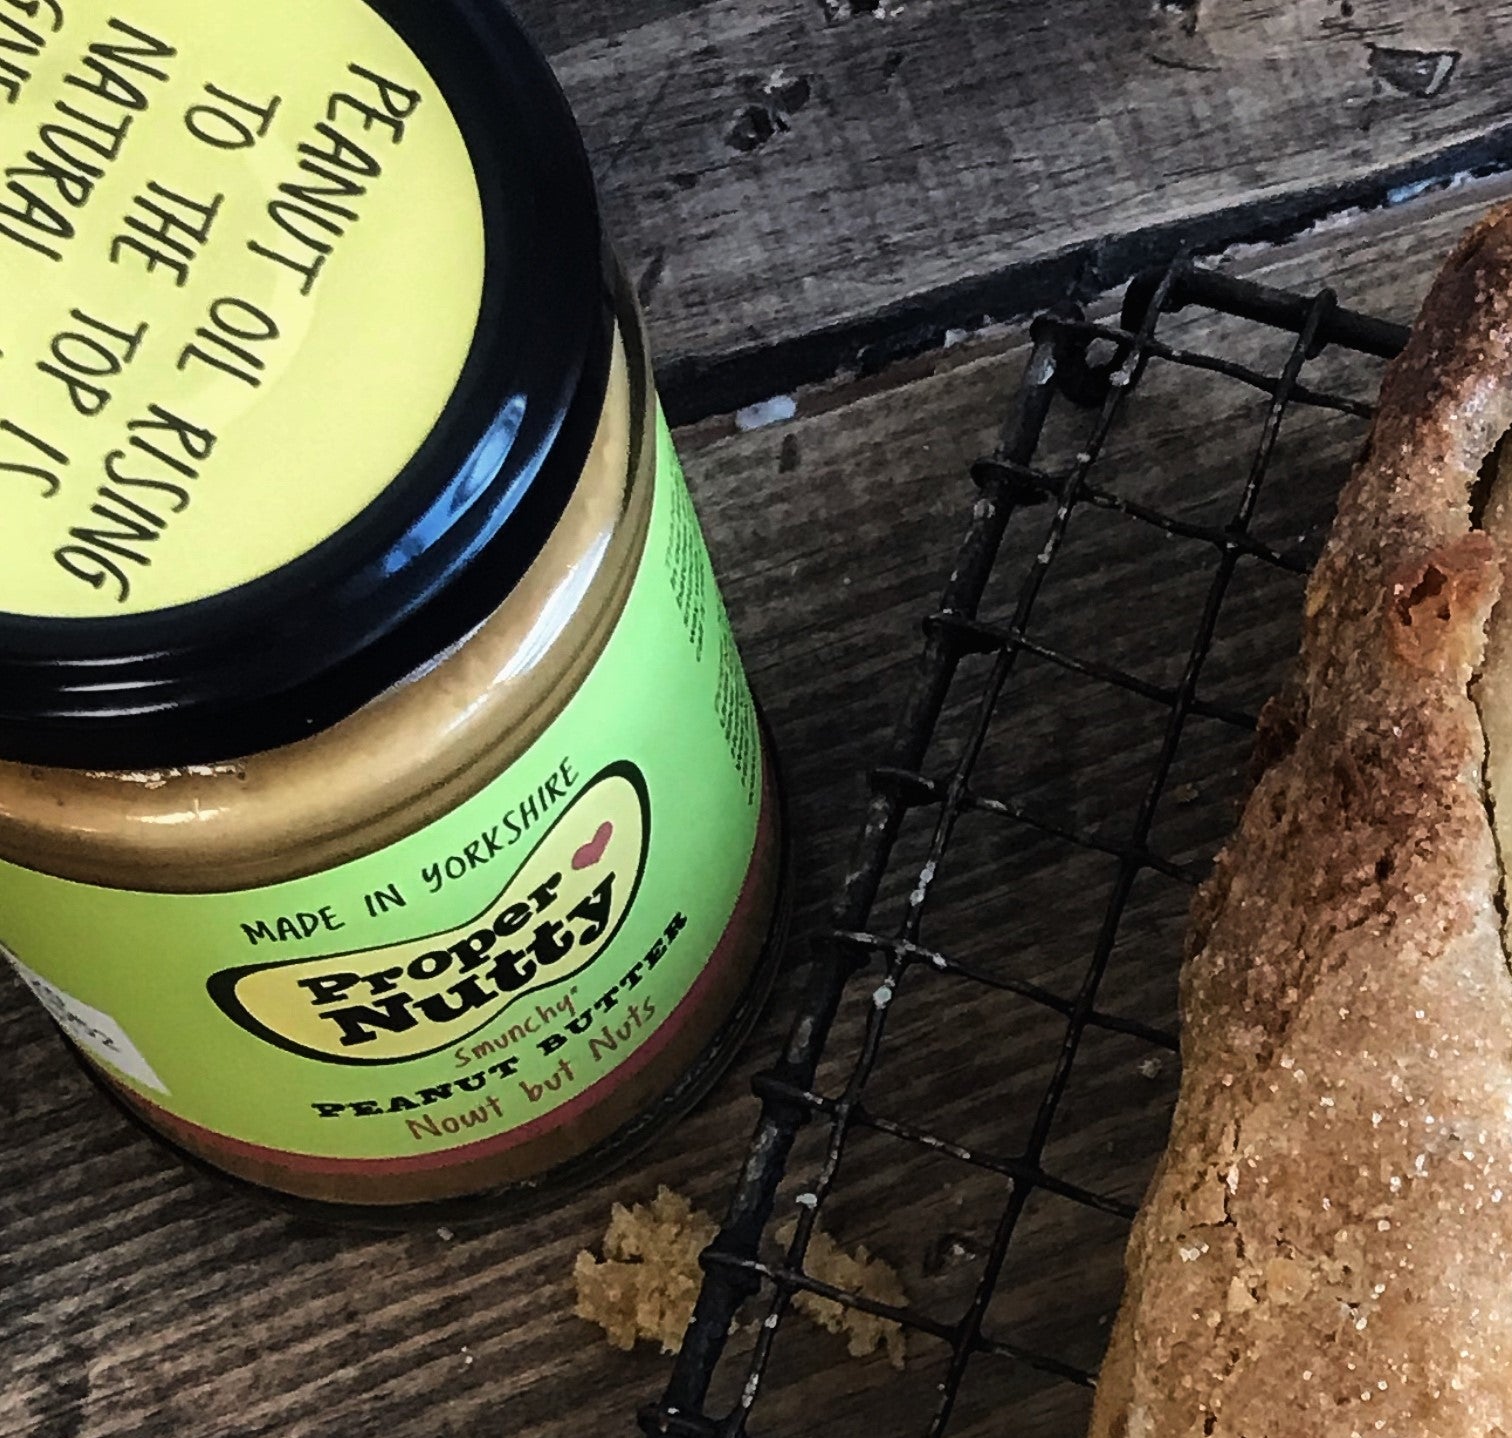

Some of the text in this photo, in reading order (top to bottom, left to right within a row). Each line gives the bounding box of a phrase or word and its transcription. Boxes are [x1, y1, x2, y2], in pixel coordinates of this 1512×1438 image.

[184, 83, 282, 150] TO
[109, 180, 224, 287] THE
[36, 307, 149, 417] TOP
[53, 62, 421, 602] PEANUT OIL RISING
[241, 756, 579, 946] MADE IN YORKSHIRE
[298, 871, 563, 1006] Proper
[319, 871, 616, 1047] Nutty
[311, 911, 688, 1118] PEANUT BUTTER
[405, 995, 657, 1141] Nowt but Nuts
